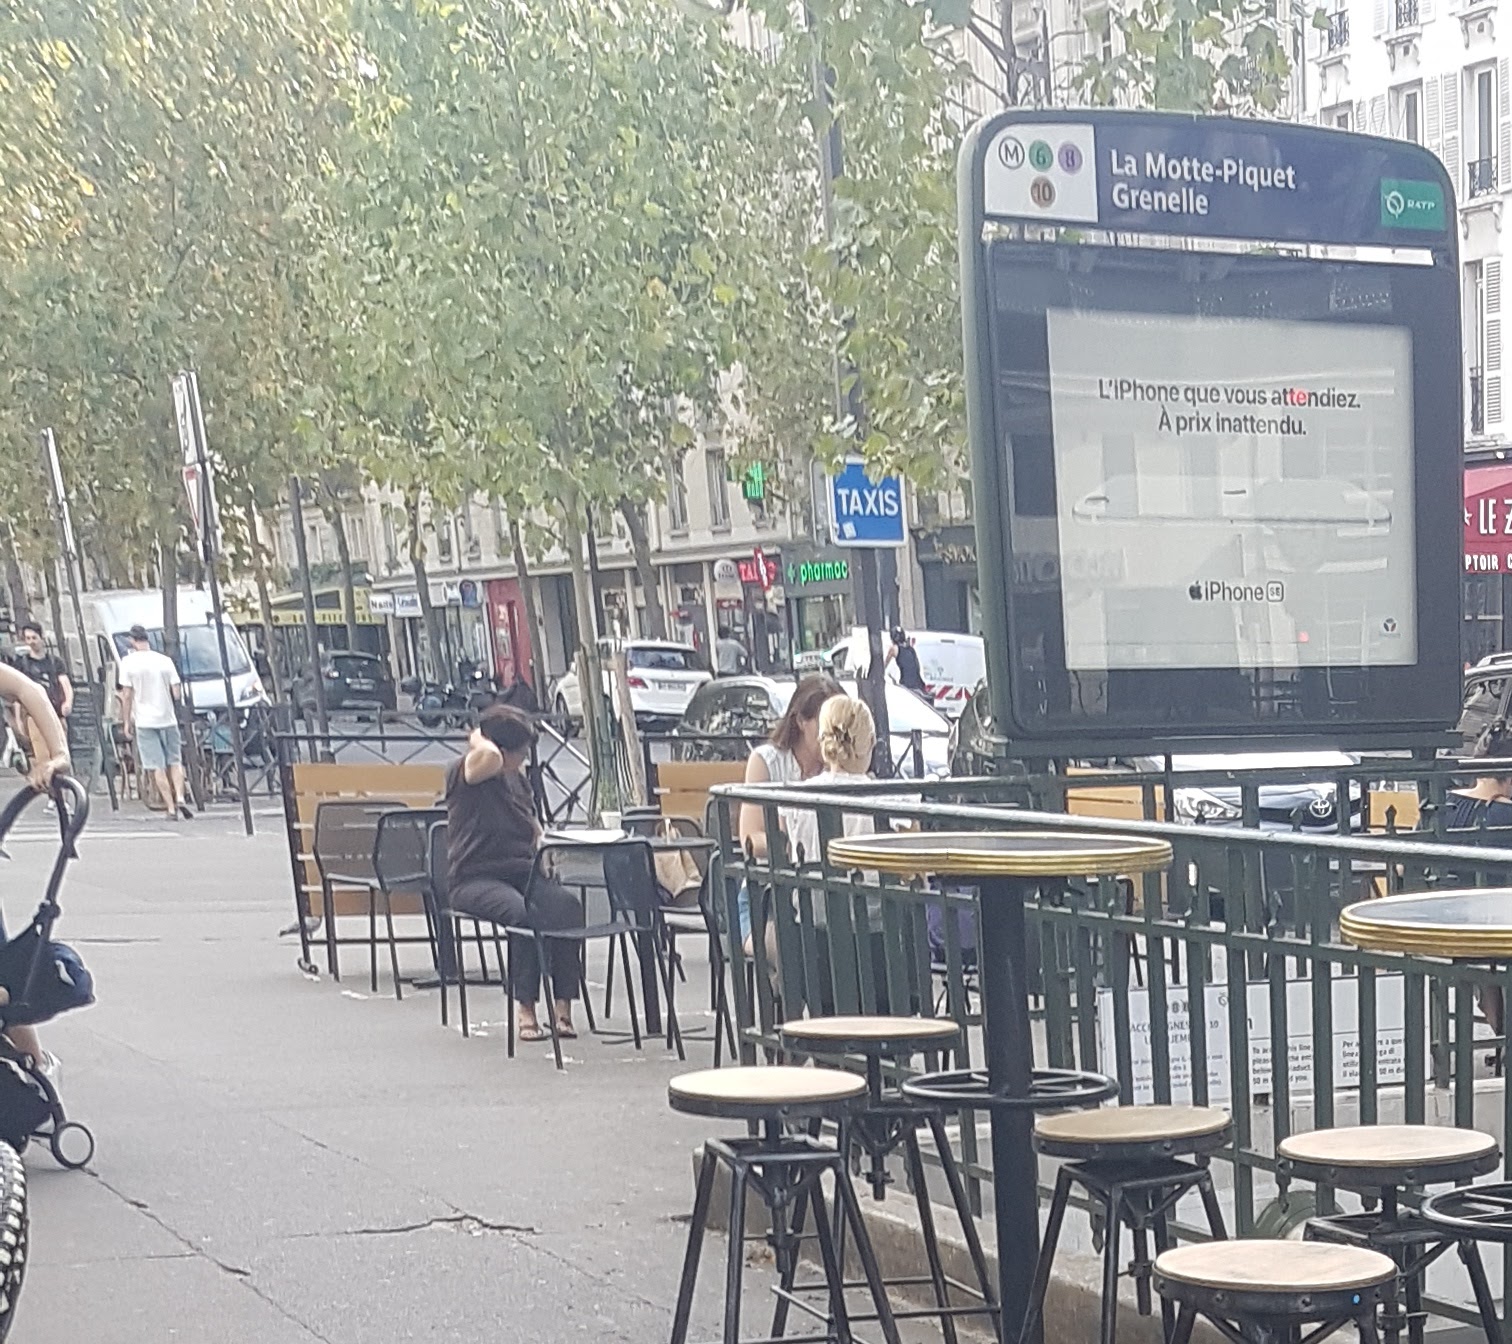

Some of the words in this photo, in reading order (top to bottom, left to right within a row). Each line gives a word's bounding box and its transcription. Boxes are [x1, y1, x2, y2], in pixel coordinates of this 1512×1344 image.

[1036, 147, 1047, 165] 6
[1110, 149, 1138, 177] La
[1146, 151, 1297, 193] Motte-Piquet
[1032, 182, 1053, 202] 10
[1112, 182, 1210, 216] Grenelle
[1407, 199, 1436, 210] RATP
[1184, 386, 1221, 408] que
[1224, 388, 1268, 406] vous
[1271, 387, 1362, 409] attendiez.
[1176, 411, 1212, 435] prix
[1216, 412, 1308, 436] inattendu.
[836, 488, 899, 517] TAXIS
[1479, 498, 1498, 535] LE
[1204, 580, 1265, 602] iPhone
